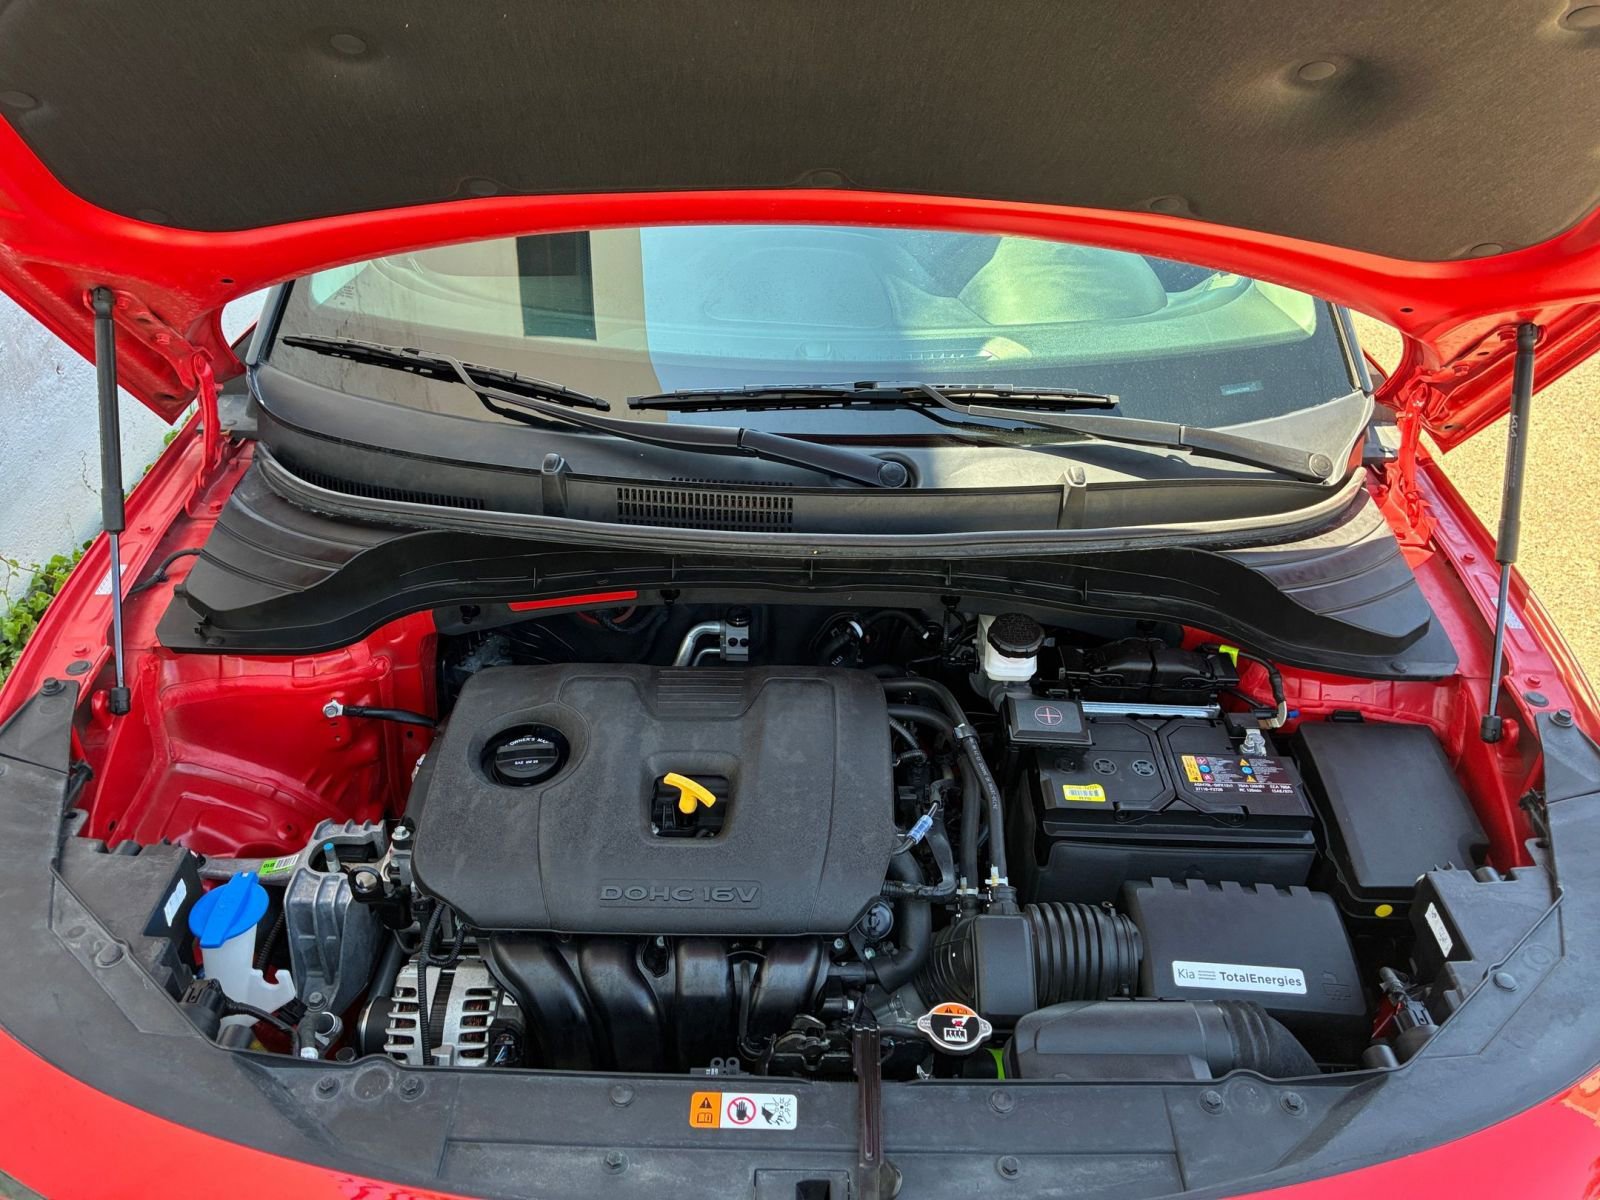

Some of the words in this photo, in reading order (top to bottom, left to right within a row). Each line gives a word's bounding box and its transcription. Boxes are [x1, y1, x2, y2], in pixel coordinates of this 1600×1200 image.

[600, 885, 695, 901] DOHC
[703, 886, 760, 903] 16V
[1177, 968, 1196, 980] Kia
[1219, 971, 1302, 987] TotalEnergies
